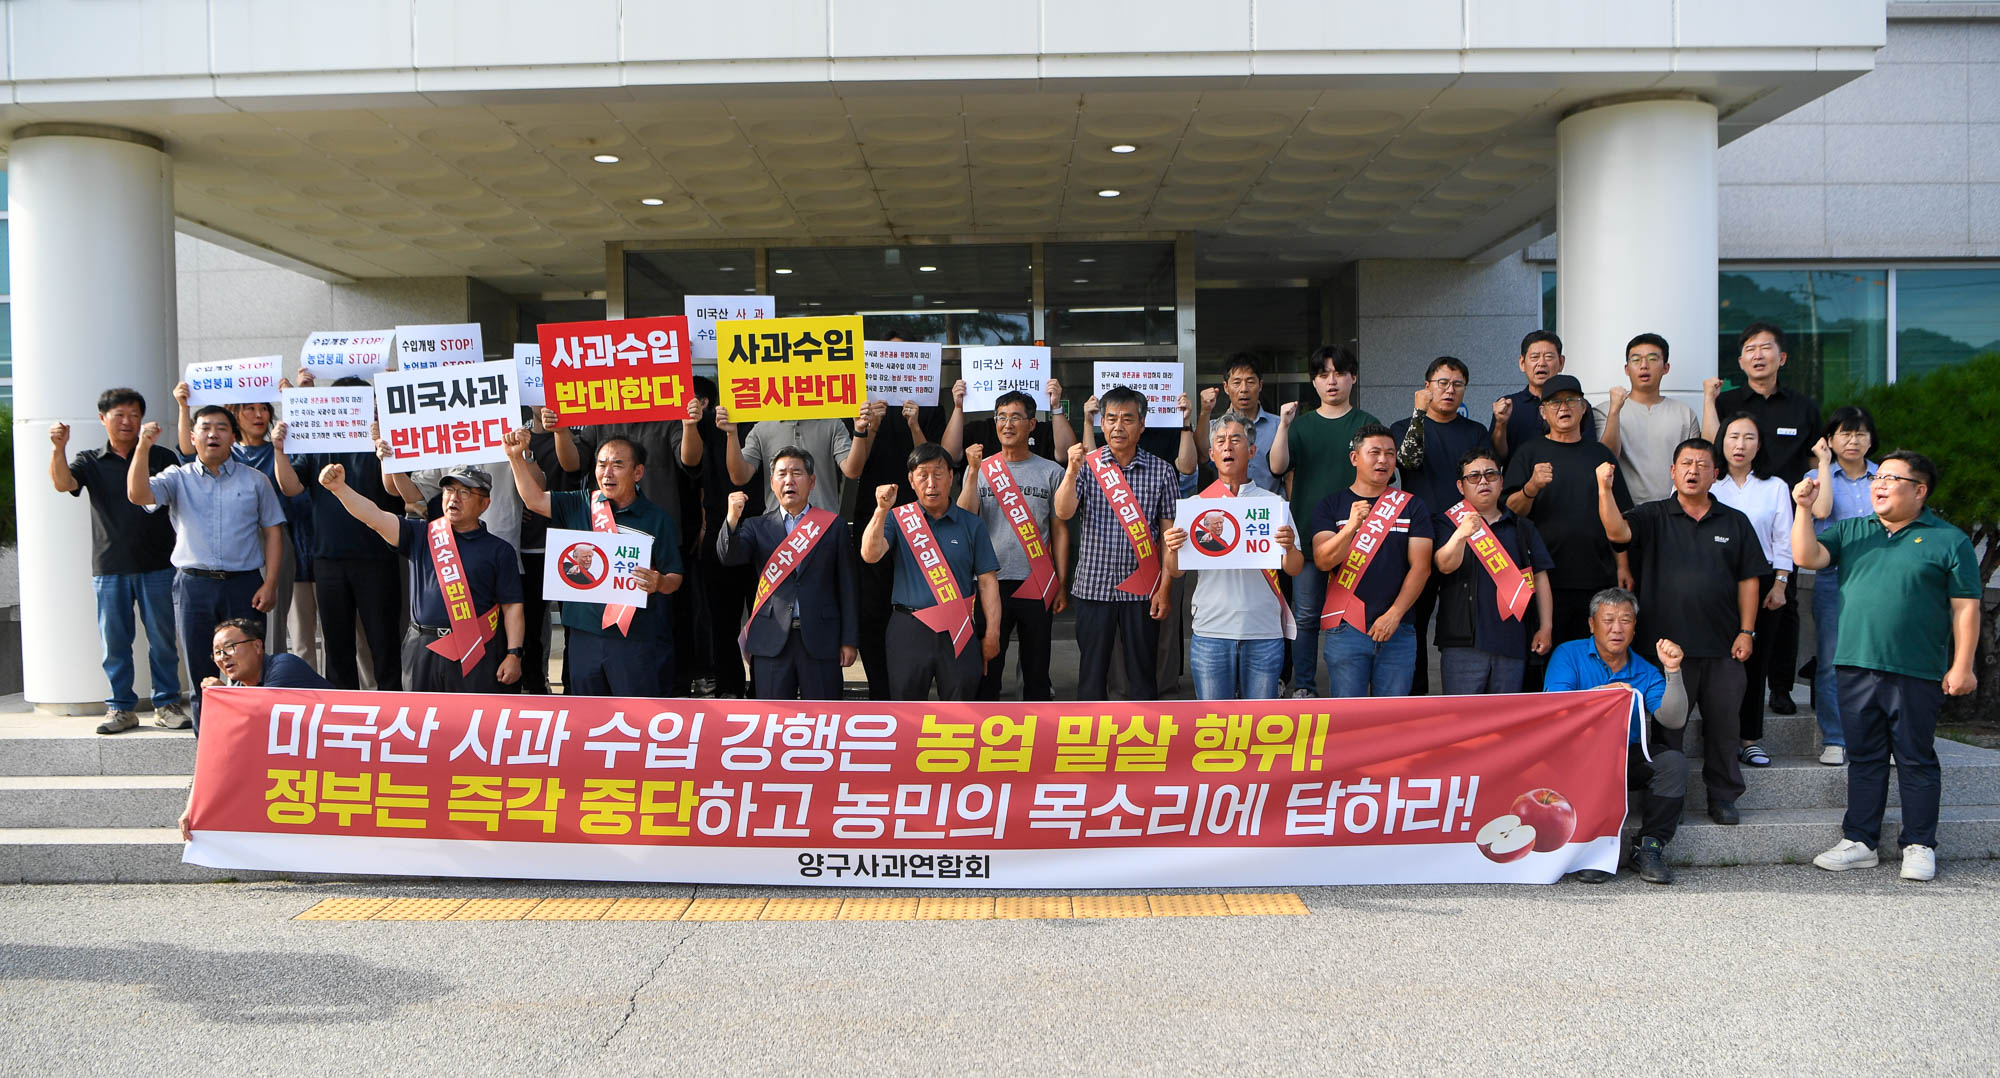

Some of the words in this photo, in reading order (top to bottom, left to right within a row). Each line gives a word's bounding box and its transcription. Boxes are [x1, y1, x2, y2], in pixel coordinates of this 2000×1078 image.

[697, 308, 728, 319] 미국산
[402, 340, 436, 352] 수입개방
[440, 338, 474, 351] STOP!
[551, 330, 680, 369] 사과수입
[728, 330, 854, 364] 사과수입
[308, 353, 343, 365] 농업붕괴
[348, 353, 380, 364] STOP!
[972, 358, 1004, 370] 미국산
[193, 377, 233, 390] 농업붕괴
[238, 376, 273, 388] STOP!
[386, 374, 508, 415] 미국사과
[555, 375, 684, 414] 반대한다
[731, 374, 857, 409] 결사반대
[972, 380, 992, 392] 수입
[998, 379, 1040, 391] 결사반대
[290, 420, 309, 428] 사과수입
[390, 417, 512, 459] 반대한다
[988, 460, 1044, 559] 사과수입반대
[1245, 508, 1270, 521] 사과
[1246, 523, 1270, 536] 수입
[1338, 490, 1406, 590] 사과수입반대
[615, 546, 640, 560] 사과
[900, 504, 957, 604] 사과수입반대
[1246, 539, 1270, 553] NO
[430, 518, 472, 621] 사과수입반대
[613, 576, 637, 590] NO
[267, 704, 440, 764] 미국산
[449, 708, 570, 767] 사과
[584, 712, 705, 770] 수입
[721, 713, 898, 772] 강행은
[916, 714, 1038, 773] 농업
[1054, 714, 1178, 773] 말살
[1192, 712, 1330, 773] 행위!
[265, 769, 429, 829] 정부는
[448, 776, 565, 834] 즉각
[580, 778, 813, 838] 중단하고
[832, 782, 1012, 840] 농민의
[1028, 783, 1270, 840] 목소리에
[1283, 776, 1480, 836] 답하라!
[798, 852, 990, 879] 양구사과연합회
